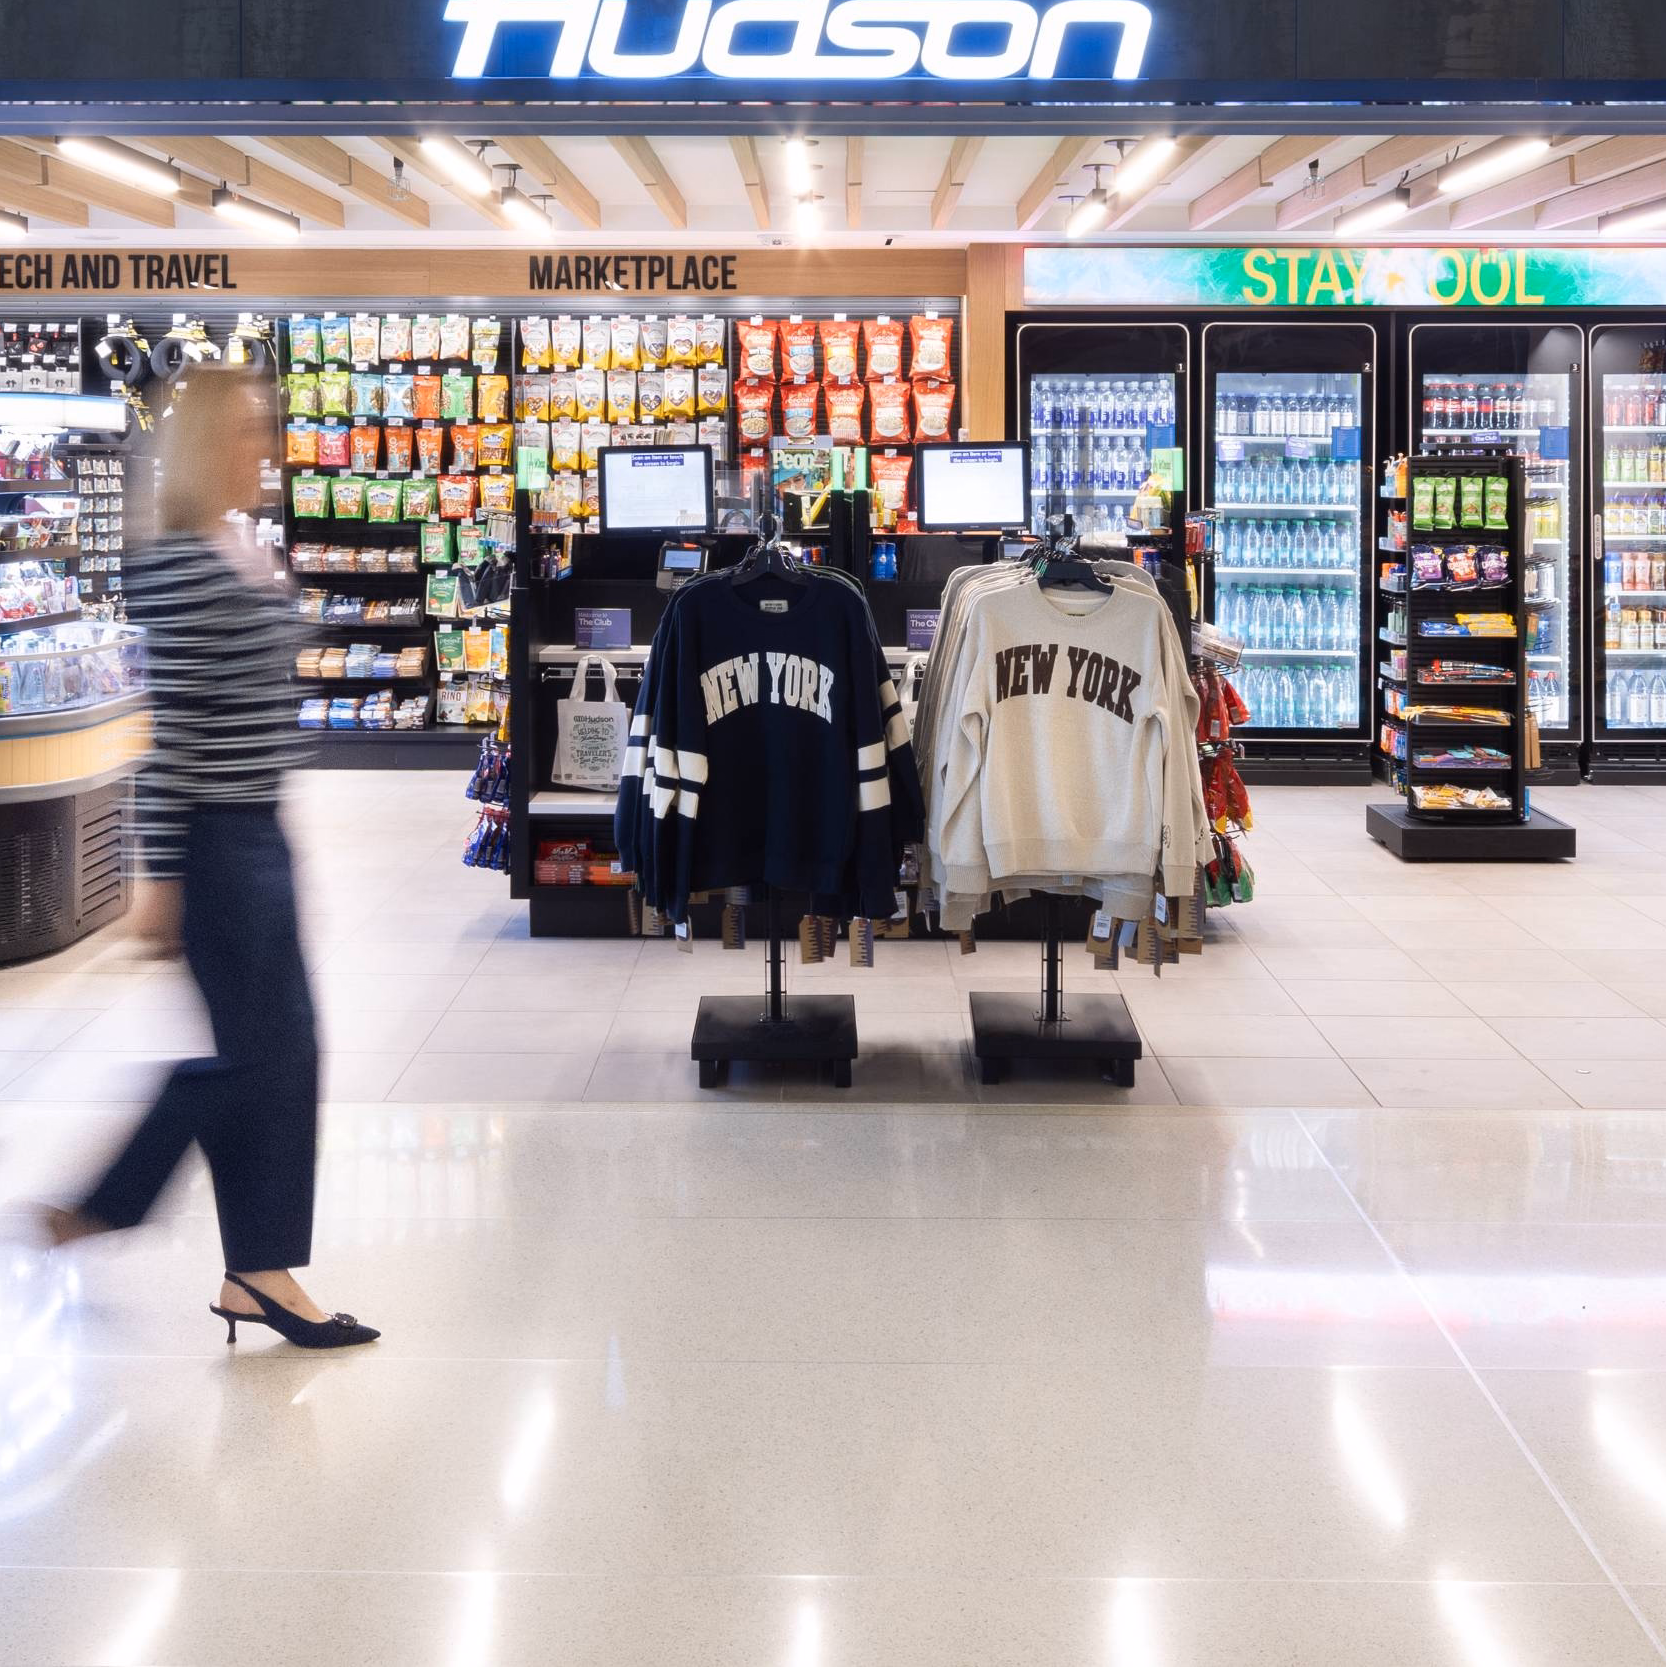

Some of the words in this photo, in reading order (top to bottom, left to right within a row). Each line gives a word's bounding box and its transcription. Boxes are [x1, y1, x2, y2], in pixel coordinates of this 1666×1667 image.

[61, 254, 120, 289] AND
[128, 254, 237, 289] TRAVEL
[529, 255, 737, 290] MARKETPLACE
[1243, 248, 1370, 305] STAY
[1413, 248, 1545, 306] OOL
[578, 618, 593, 626] The
[594, 618, 612, 626] Club
[910, 619, 925, 627] The
[700, 653, 759, 725] NEW
[765, 652, 835, 724] YORK
[995, 643, 1059, 704] NEW
[1066, 645, 1142, 725] YORK
[586, 715, 614, 723] Hudson
